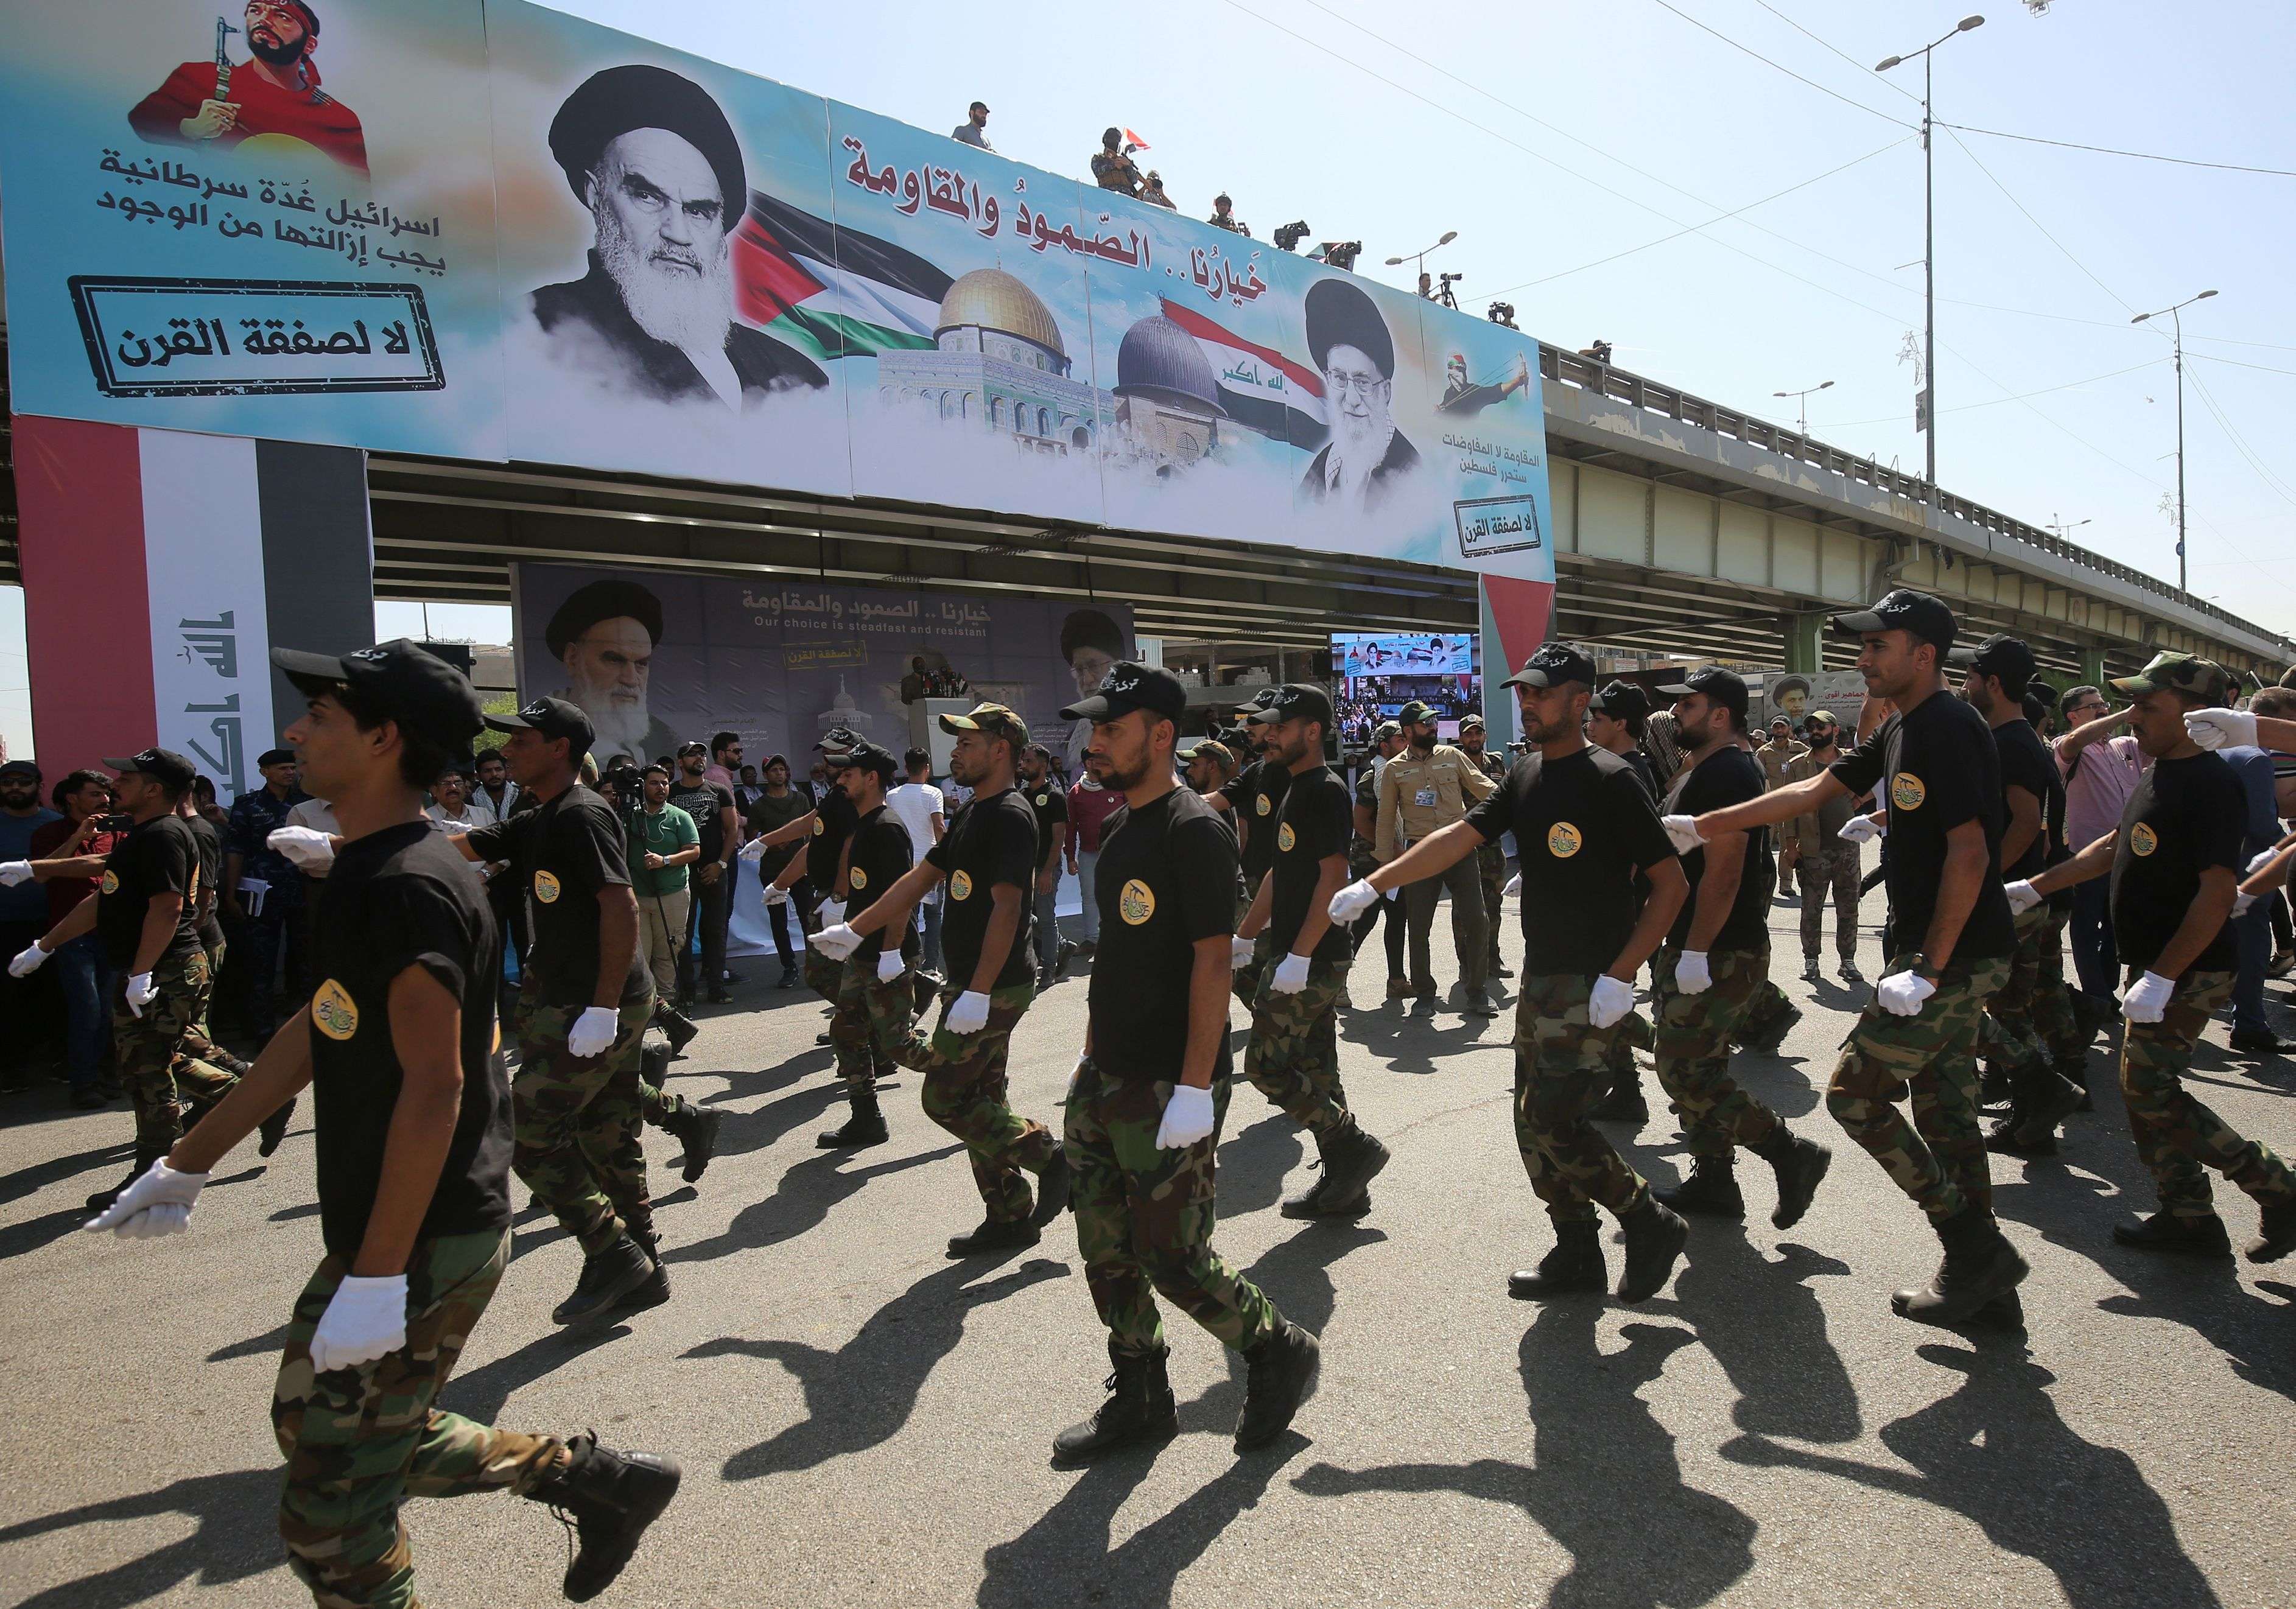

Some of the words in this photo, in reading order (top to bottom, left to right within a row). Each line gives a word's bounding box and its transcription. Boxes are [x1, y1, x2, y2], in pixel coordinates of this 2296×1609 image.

[99, 148, 248, 200] سرطانية
[841, 134, 1000, 239] والمقاومة
[96, 192, 208, 230] الوجود
[326, 199, 440, 239] اسرائيل
[219, 215, 263, 239] من
[275, 219, 369, 268] إزالتها
[376, 246, 447, 278] يجب
[118, 317, 231, 368] القرن
[237, 318, 371, 356] لصفقة
[383, 319, 410, 354] لا
[1442, 433, 1493, 456] المفاوضات
[1495, 445, 1501, 458] لا
[1459, 458, 1497, 476] فلسطين
[1504, 448, 1540, 468] المقاومة
[1465, 517, 1490, 544] القرن
[1492, 514, 1522, 535] لصفقة
[1524, 513, 1532, 531] لا
[742, 590, 843, 618] والمقاومة
[848, 600, 919, 619] الصمود
[941, 601, 992, 626] خيارنا
[754, 616, 778, 627] Our
[784, 617, 827, 629] choice
[832, 619, 844, 629] is
[848, 621, 906, 633] steadfast
[910, 624, 931, 634] and
[935, 627, 987, 637] resistant
[788, 651, 816, 663] القرن
[818, 649, 852, 659] لصفقة
[854, 647, 862, 657] لا
[184, 693, 251, 810] اكب
